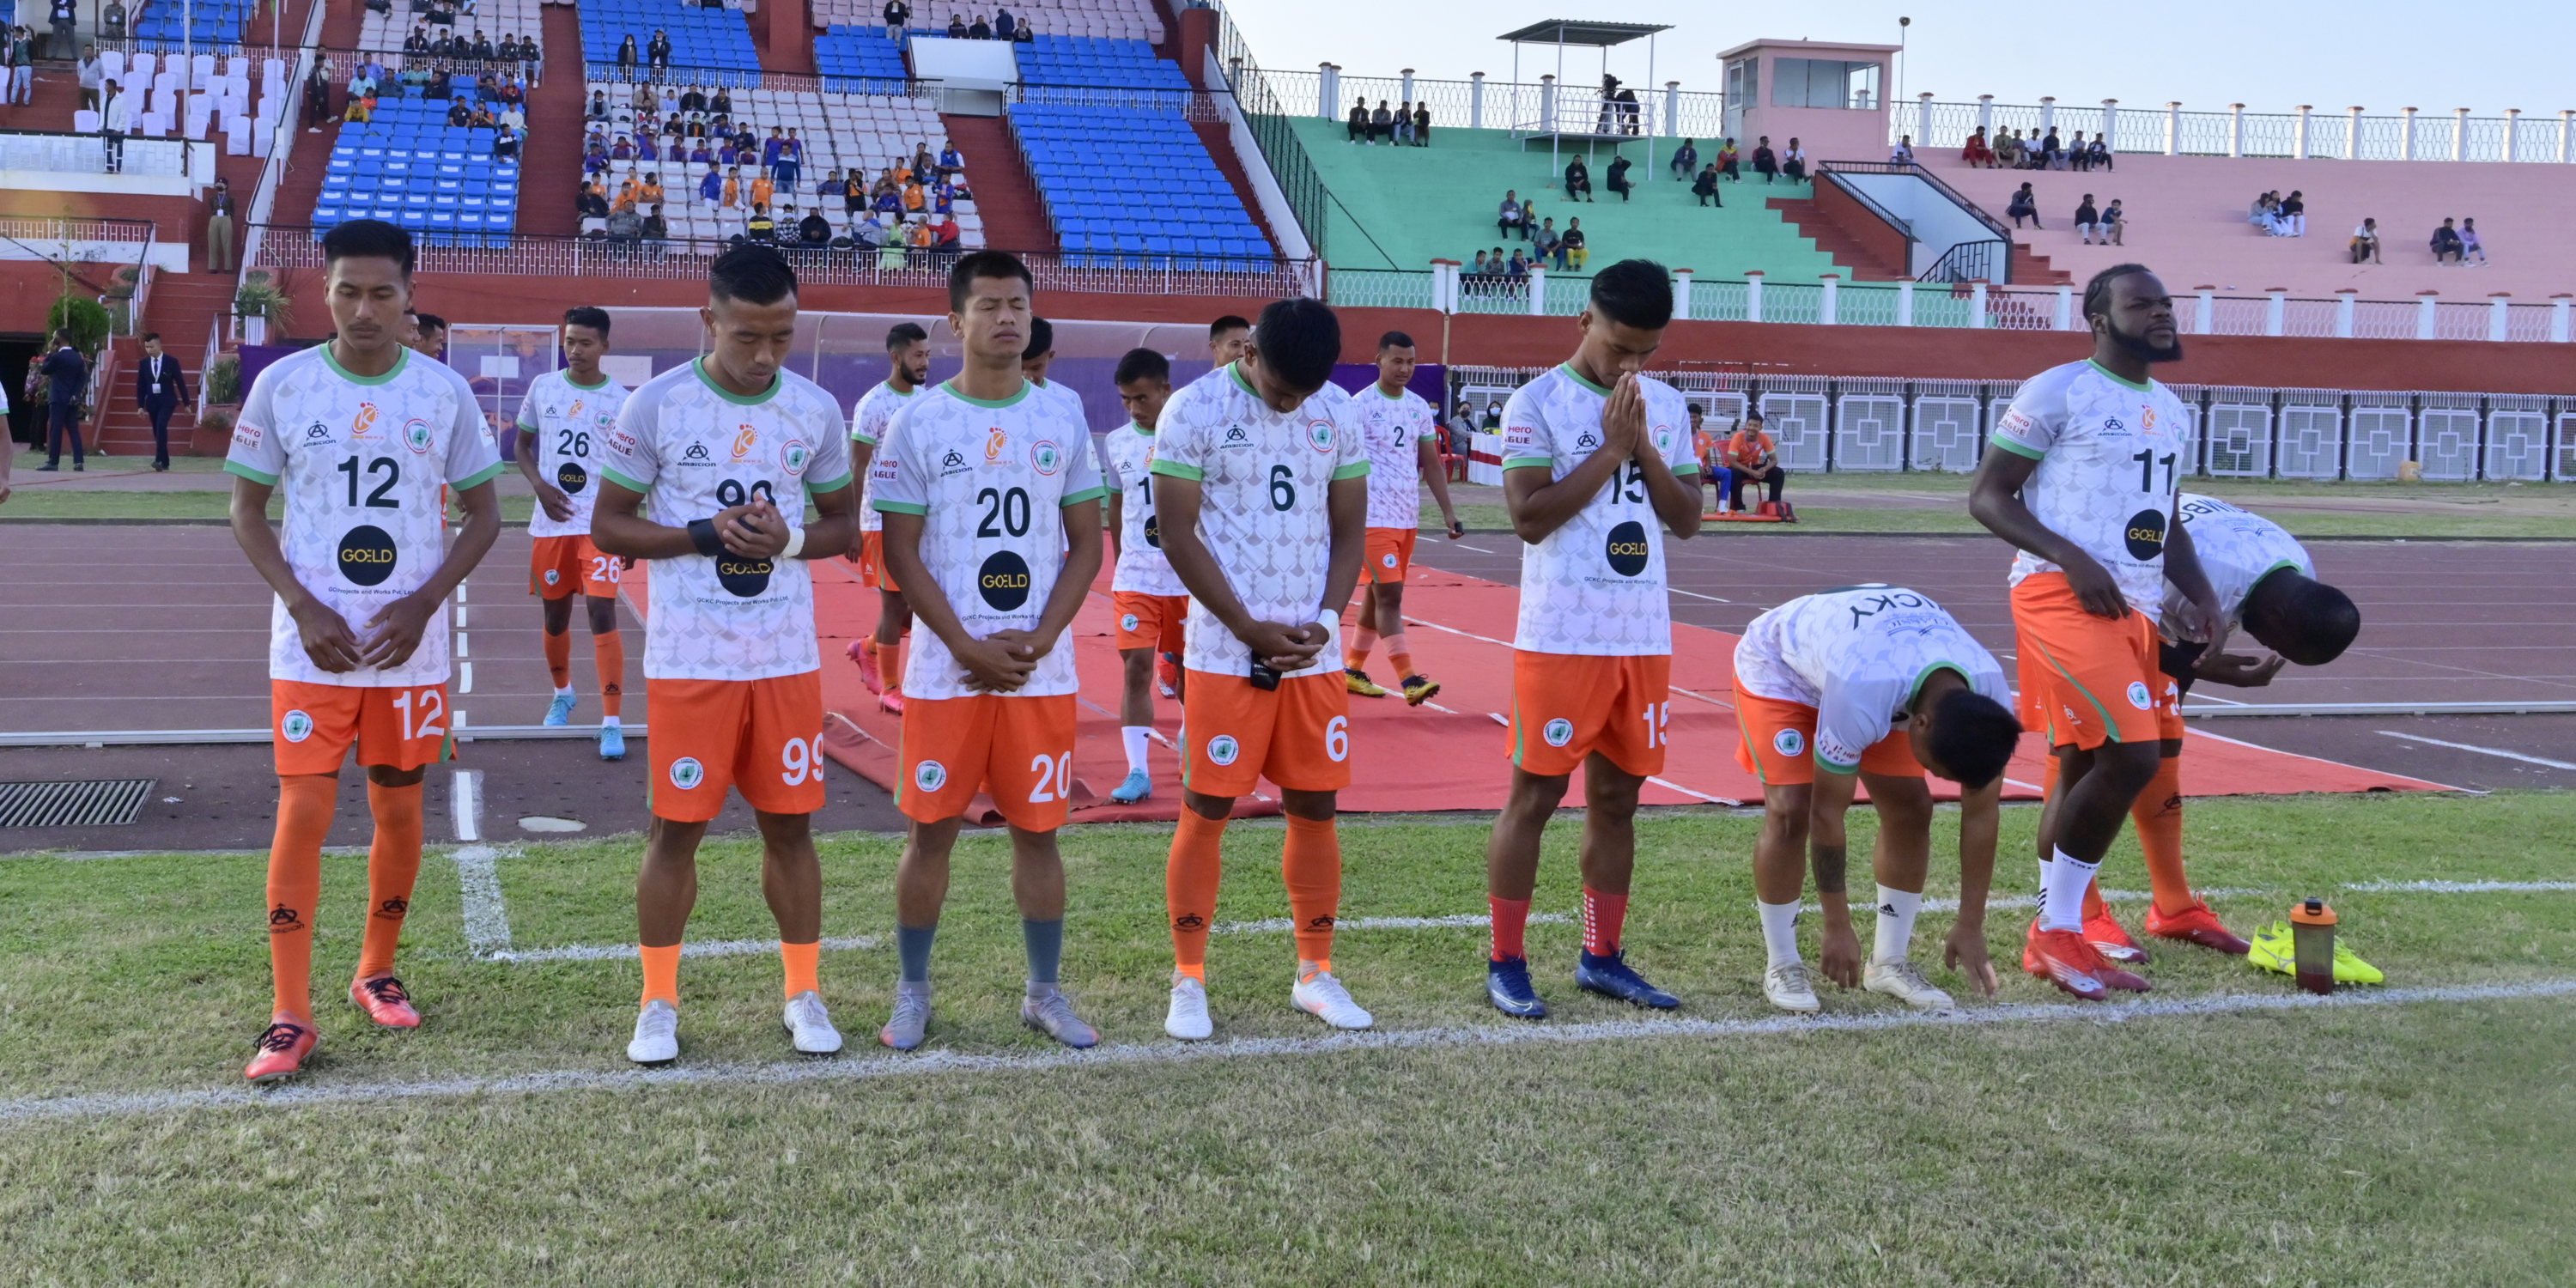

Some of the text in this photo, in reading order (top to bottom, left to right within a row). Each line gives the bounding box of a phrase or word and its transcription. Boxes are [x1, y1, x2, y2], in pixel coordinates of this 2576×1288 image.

[238, 424, 261, 438] Hero
[557, 428, 590, 458] 26
[616, 430, 635, 446] Hero
[1394, 426, 1405, 447] 2
[2011, 413, 2030, 428] Hero
[337, 455, 400, 509] 12
[880, 459, 897, 468] Hero
[1612, 460, 1643, 504] 15
[2133, 448, 2176, 495] 11
[1270, 465, 1296, 512] 6
[976, 487, 1030, 538] 20
[591, 556, 620, 583] 26
[392, 689, 445, 741] 12
[1325, 714, 1348, 762] 6
[1643, 700, 1668, 750] 15
[781, 732, 824, 786] 99
[1029, 750, 1071, 803] 20
